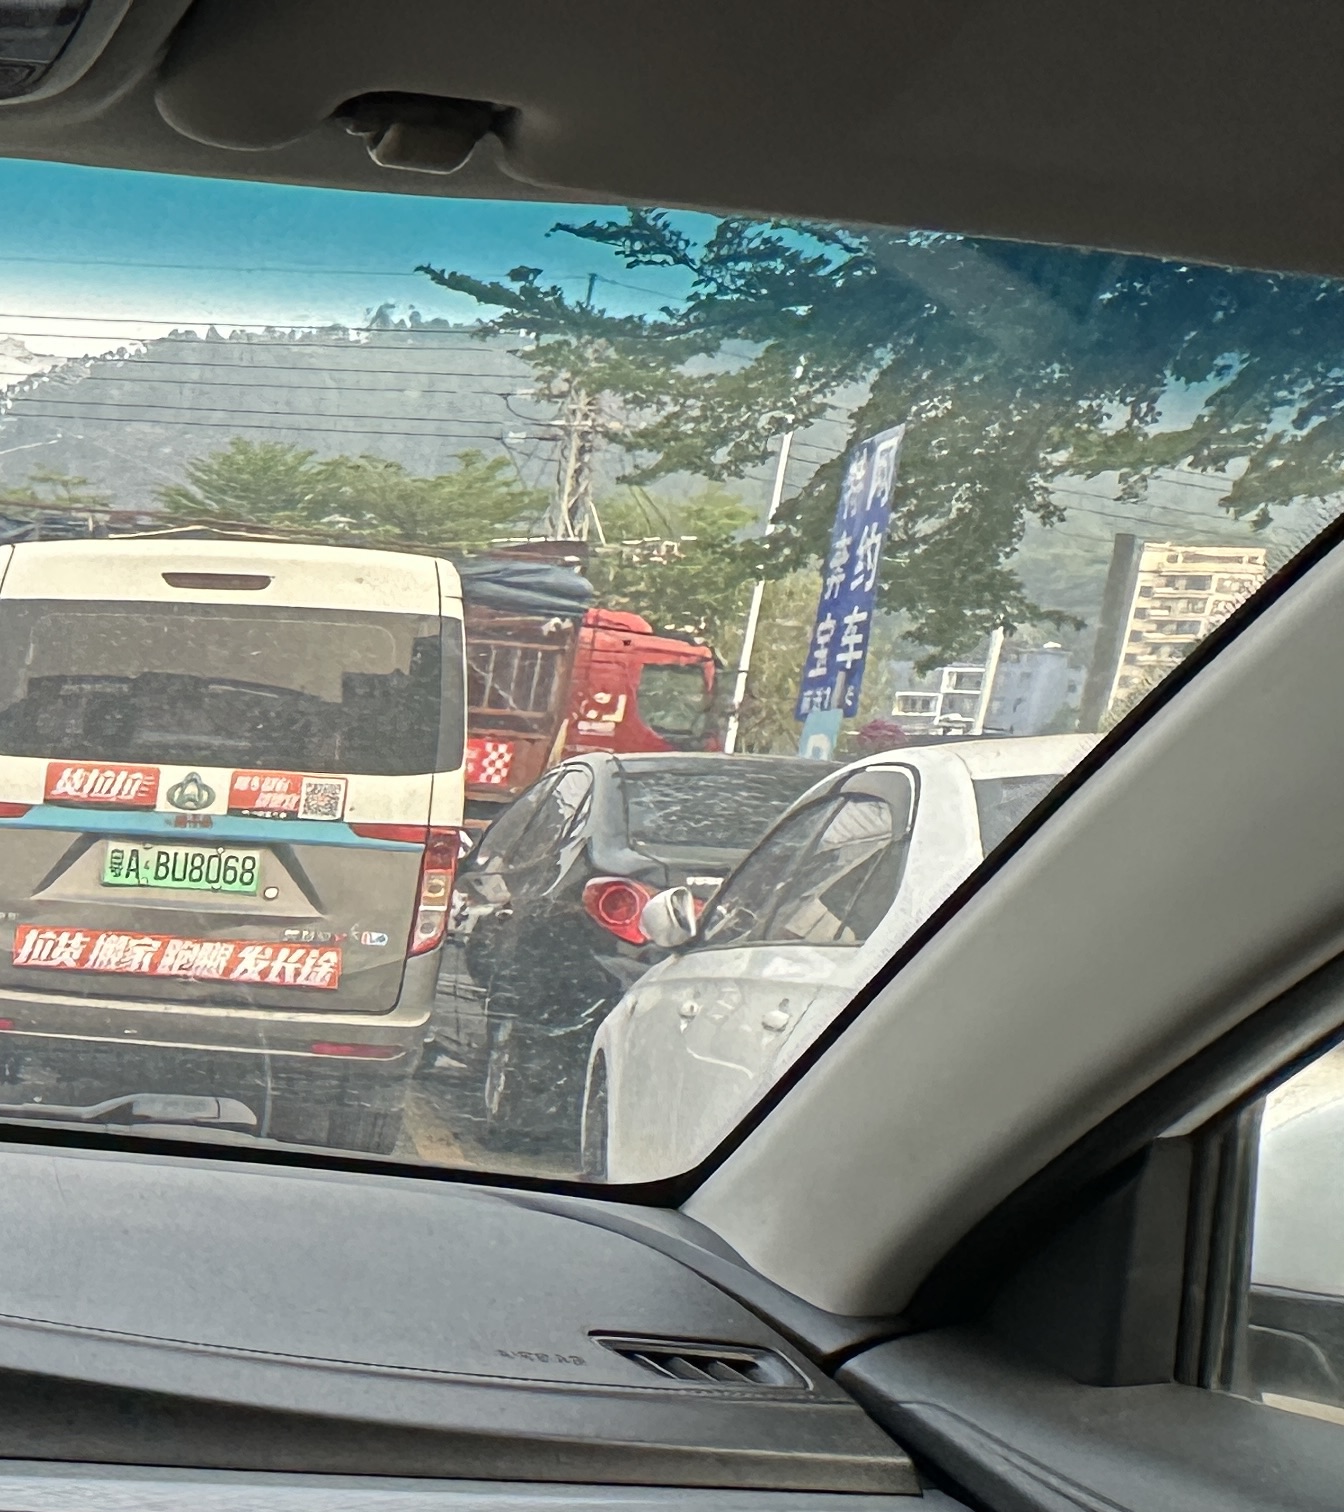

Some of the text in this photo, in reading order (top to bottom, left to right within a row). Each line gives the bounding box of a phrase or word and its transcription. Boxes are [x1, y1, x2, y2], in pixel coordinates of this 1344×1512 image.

[15, 928, 89, 966] 拉货
[230, 946, 338, 988] 发长途
